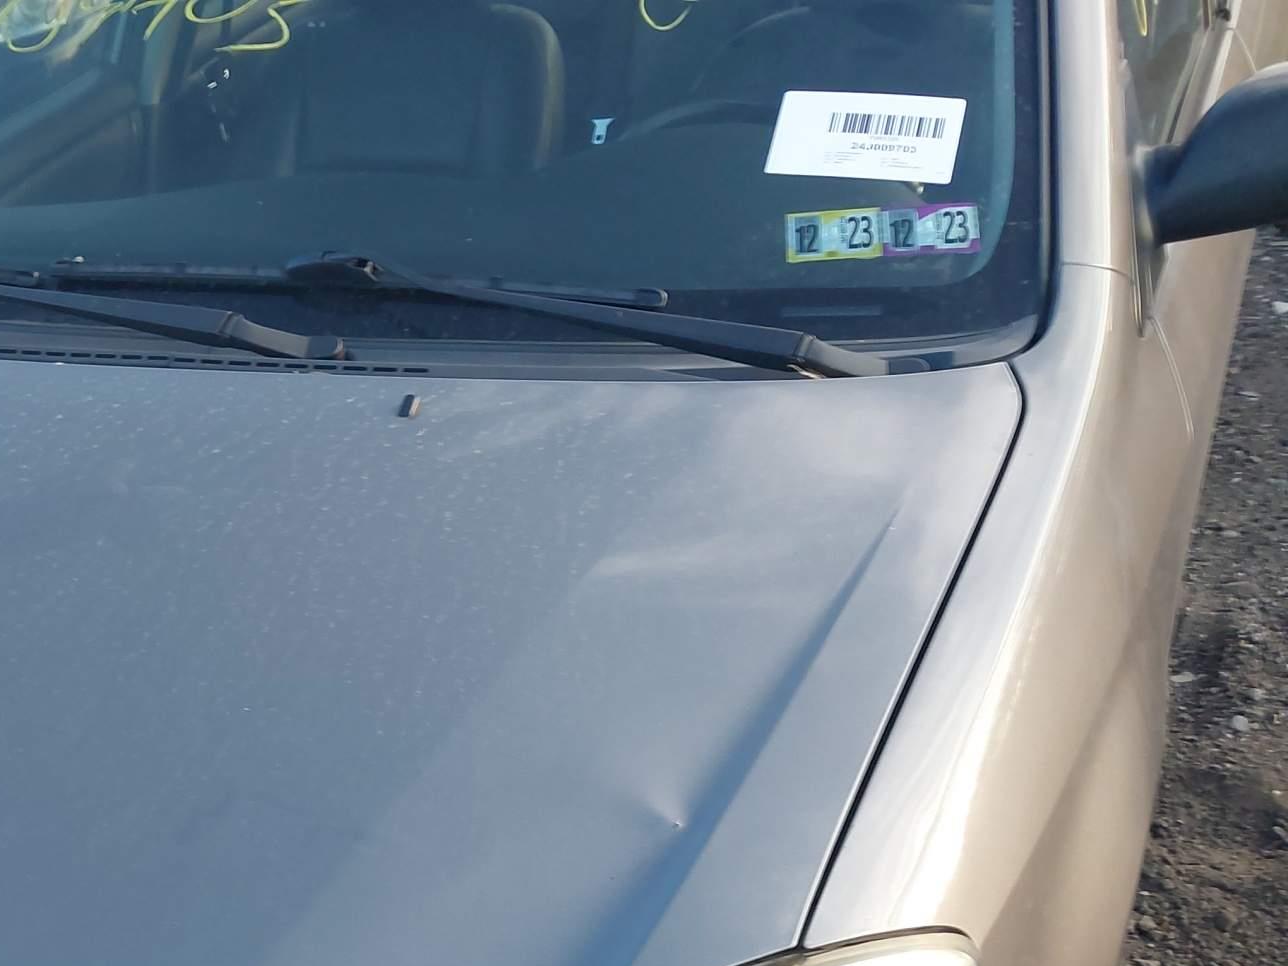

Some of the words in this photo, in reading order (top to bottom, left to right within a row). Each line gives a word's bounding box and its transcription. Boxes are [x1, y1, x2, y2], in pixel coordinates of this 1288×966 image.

[794, 224, 819, 253] 12
[847, 215, 874, 249] 23
[889, 218, 915, 248] 12
[942, 210, 970, 244] 23
